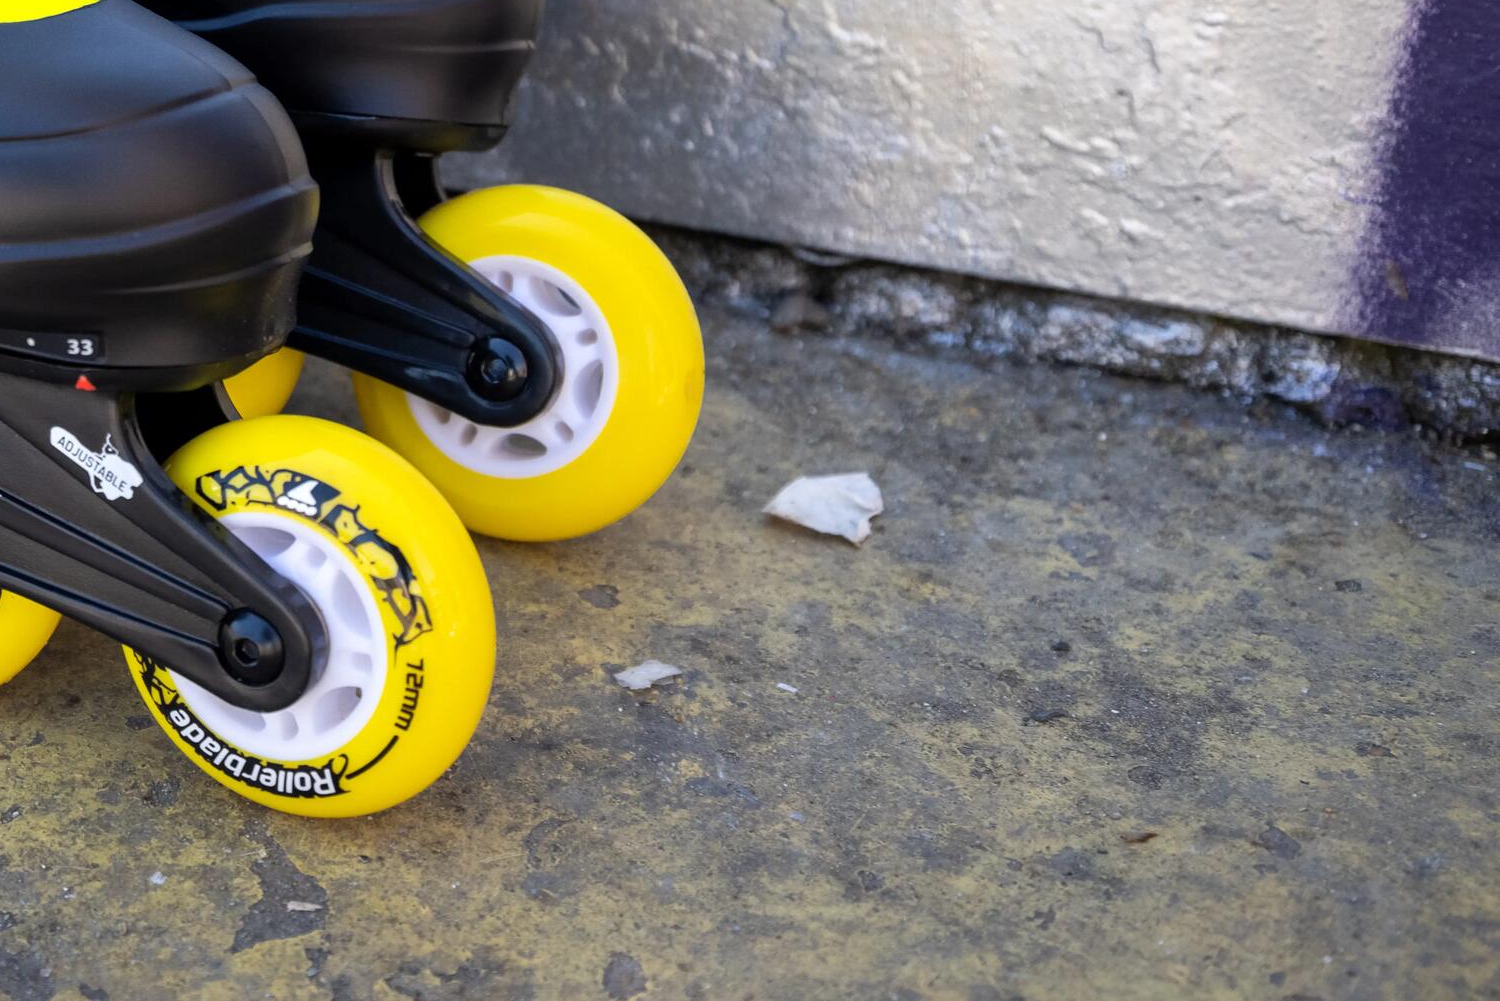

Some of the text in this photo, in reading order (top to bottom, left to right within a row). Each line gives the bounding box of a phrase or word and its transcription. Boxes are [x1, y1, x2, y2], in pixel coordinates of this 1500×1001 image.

[66, 338, 94, 356] 33
[57, 436, 128, 492] ADJUSTABLE
[394, 658, 424, 731] 72mm
[170, 708, 336, 796] Rollerblade
